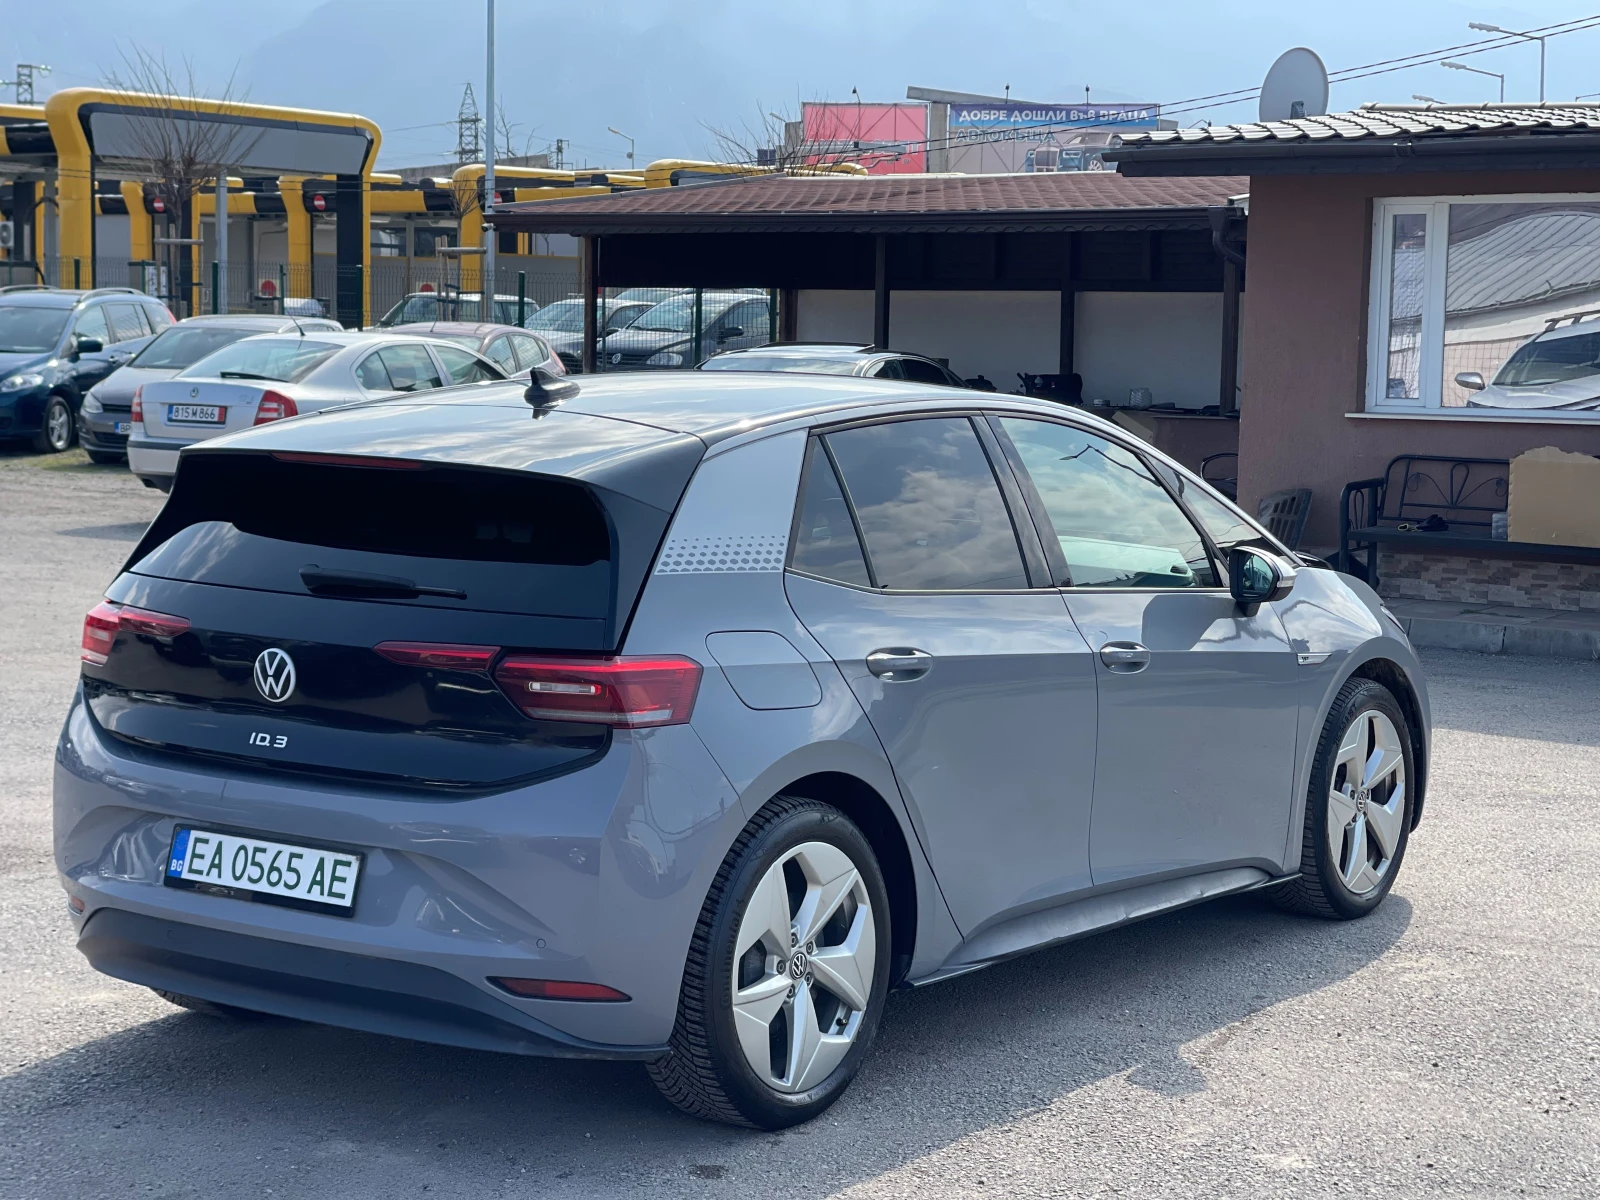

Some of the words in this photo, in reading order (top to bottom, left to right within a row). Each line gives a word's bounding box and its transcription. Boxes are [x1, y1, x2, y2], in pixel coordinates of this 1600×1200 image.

[959, 110, 1007, 122] ДОБРЕ
[1011, 110, 1066, 122] ДОШЛИ
[955, 129, 1056, 143] АВТОКЪЩА
[170, 858, 183, 872] BG
[187, 837, 222, 879] EA
[231, 844, 303, 890] 0565
[306, 857, 352, 900] AE
